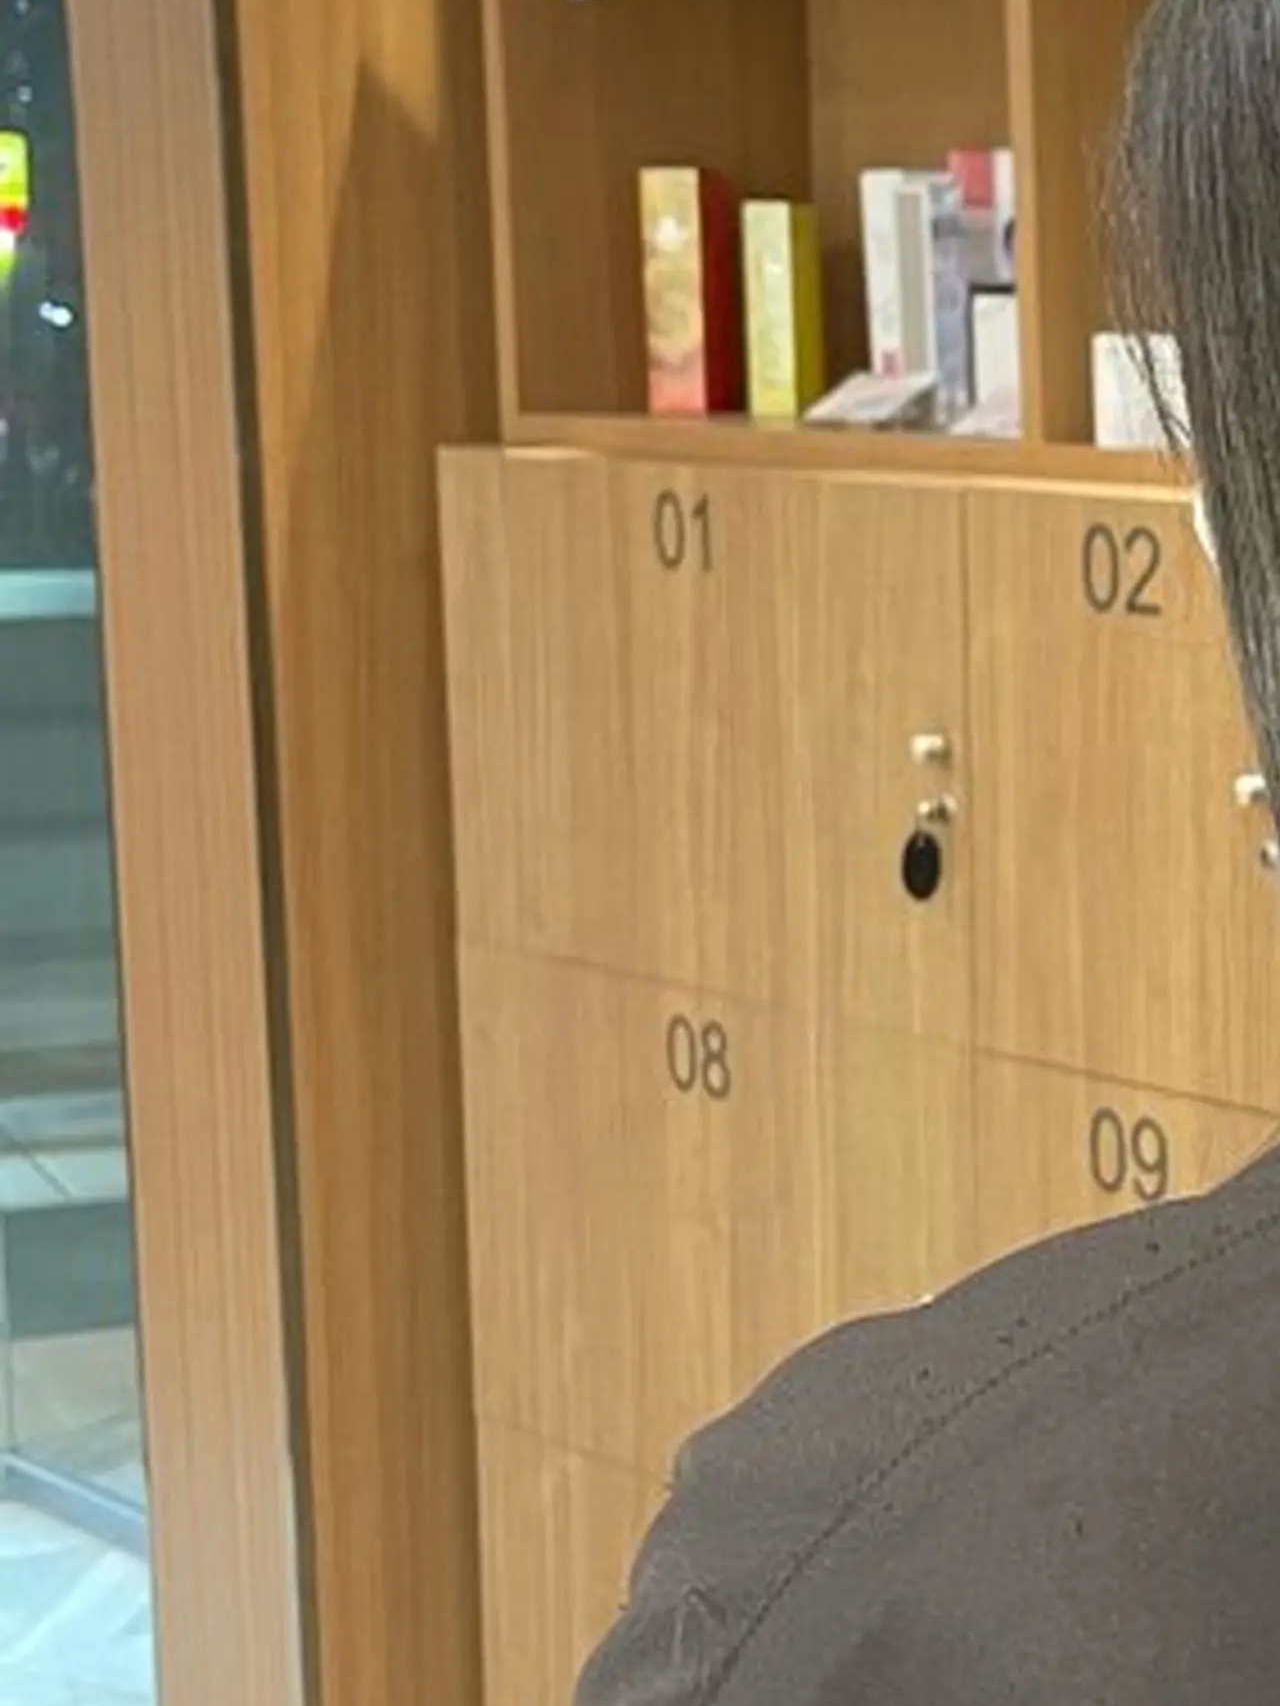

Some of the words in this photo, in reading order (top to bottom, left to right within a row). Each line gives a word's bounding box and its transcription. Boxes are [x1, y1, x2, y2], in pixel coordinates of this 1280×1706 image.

[654, 490, 712, 572] 01
[1083, 524, 1161, 615] 02
[667, 1015, 731, 1098] 08
[1090, 1107, 1168, 1201] 09
